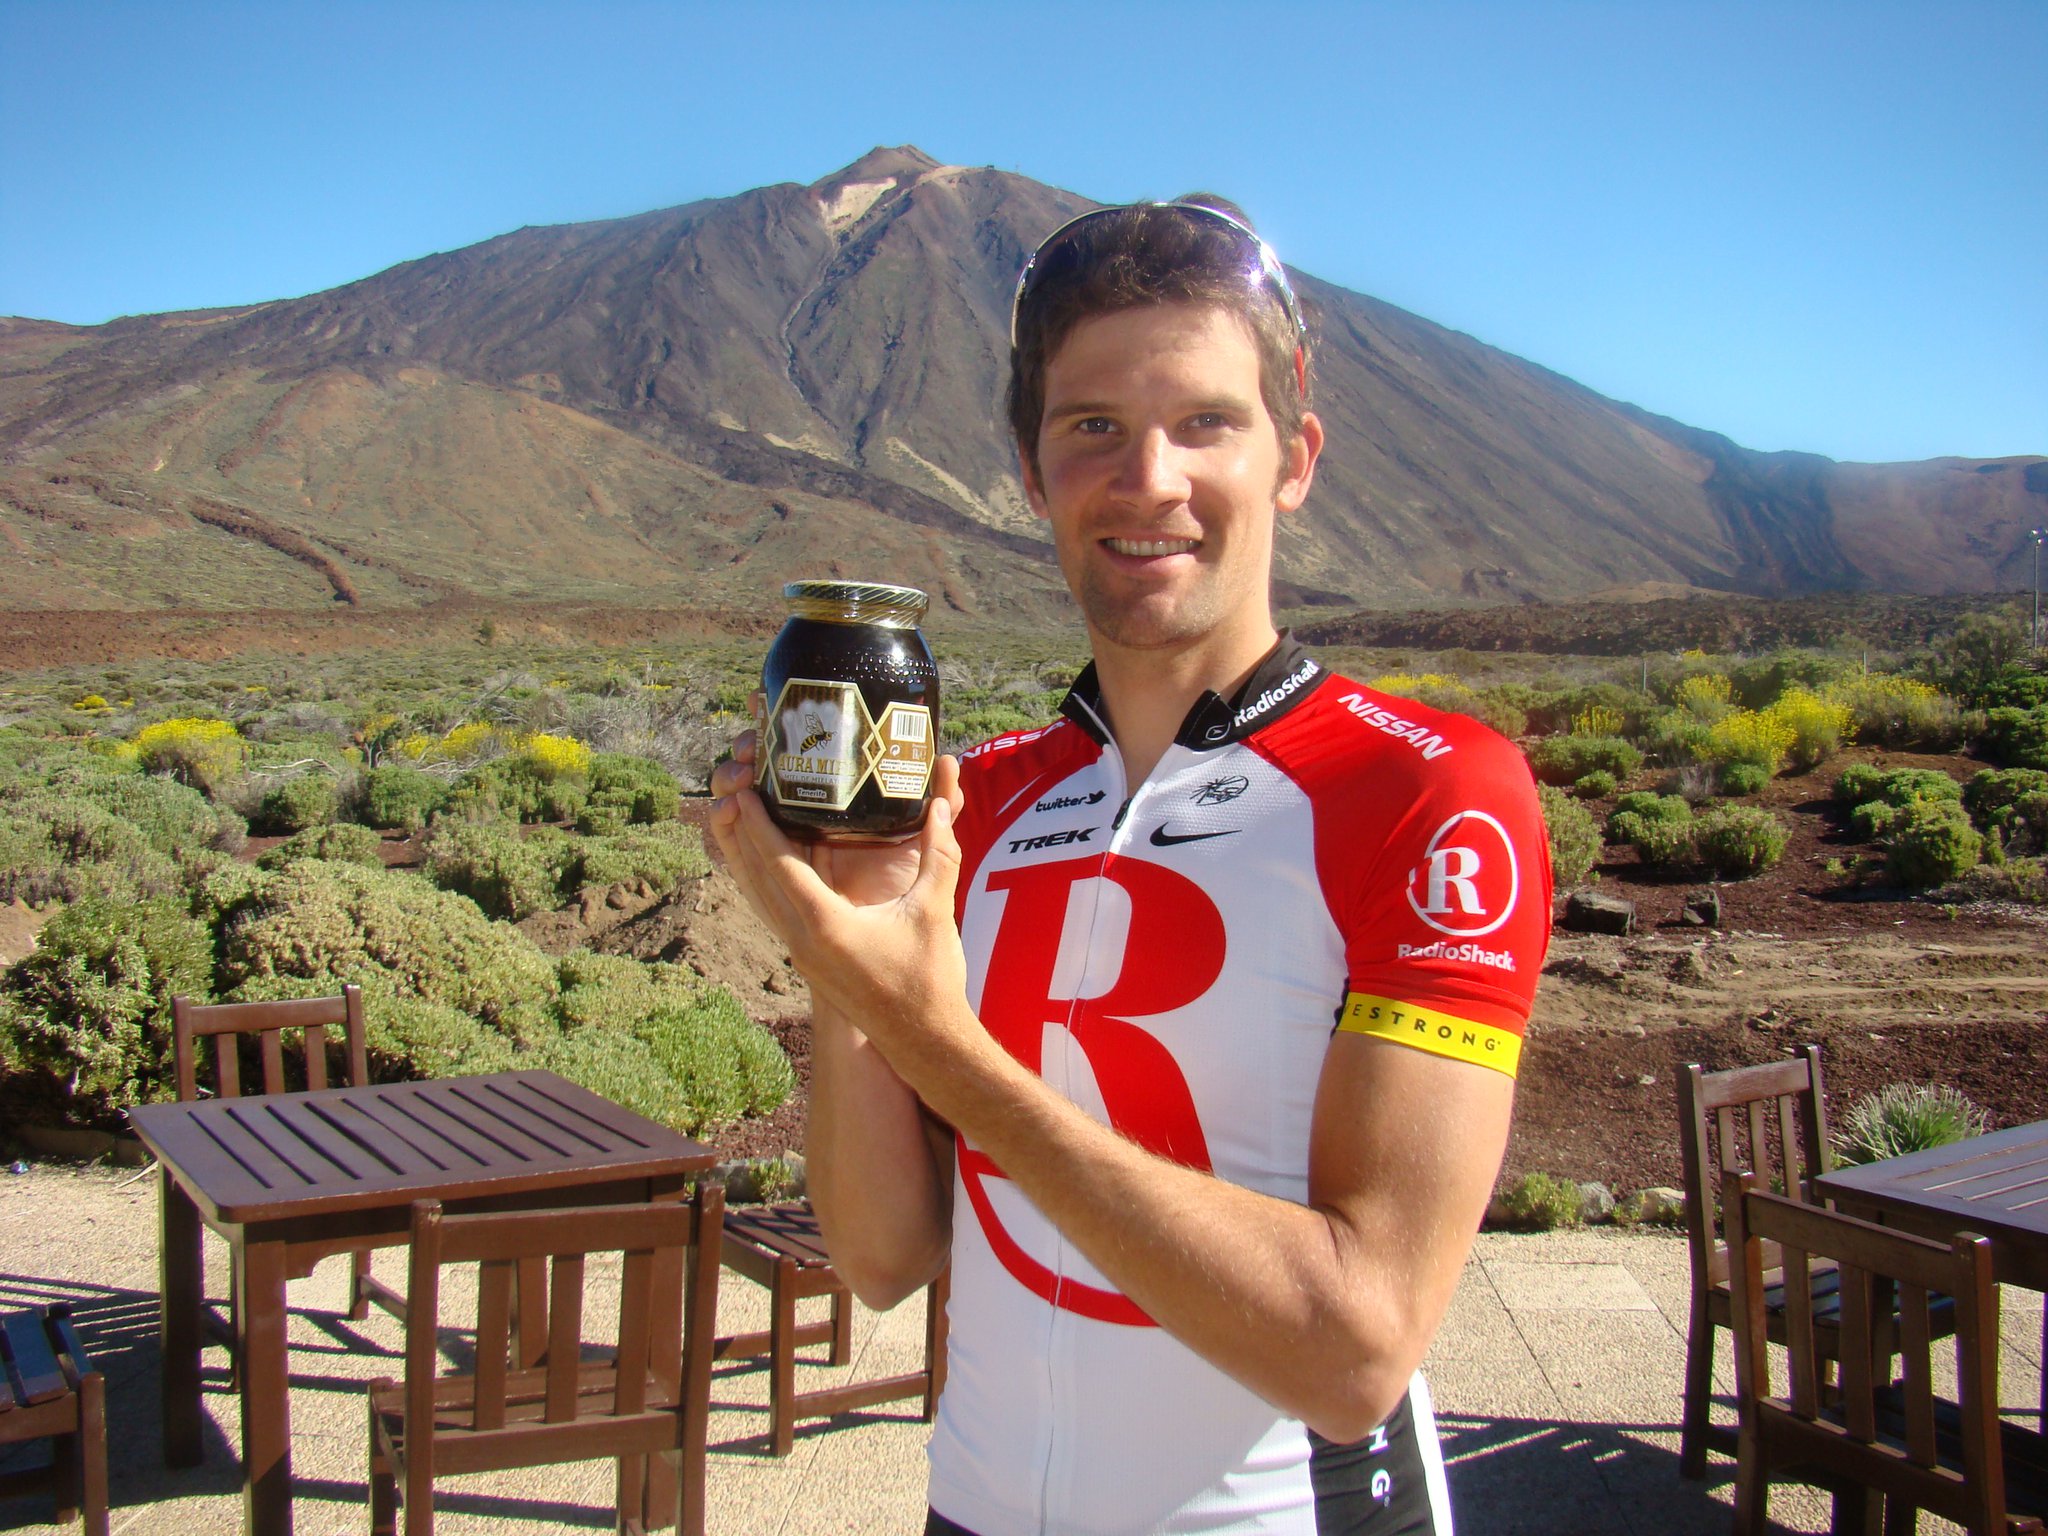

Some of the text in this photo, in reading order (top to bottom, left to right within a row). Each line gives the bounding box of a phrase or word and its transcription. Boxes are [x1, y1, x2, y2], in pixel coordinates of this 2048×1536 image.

[1336, 693, 1453, 762] NISSAN
[957, 720, 1071, 766] NISSA
[778, 753, 813, 774] AURA
[797, 788, 827, 798] Tenerife
[1035, 794, 1087, 813] twitter
[1008, 826, 1101, 855] TREK
[1421, 846, 1487, 915] R
[1397, 942, 1514, 971] RadioShack
